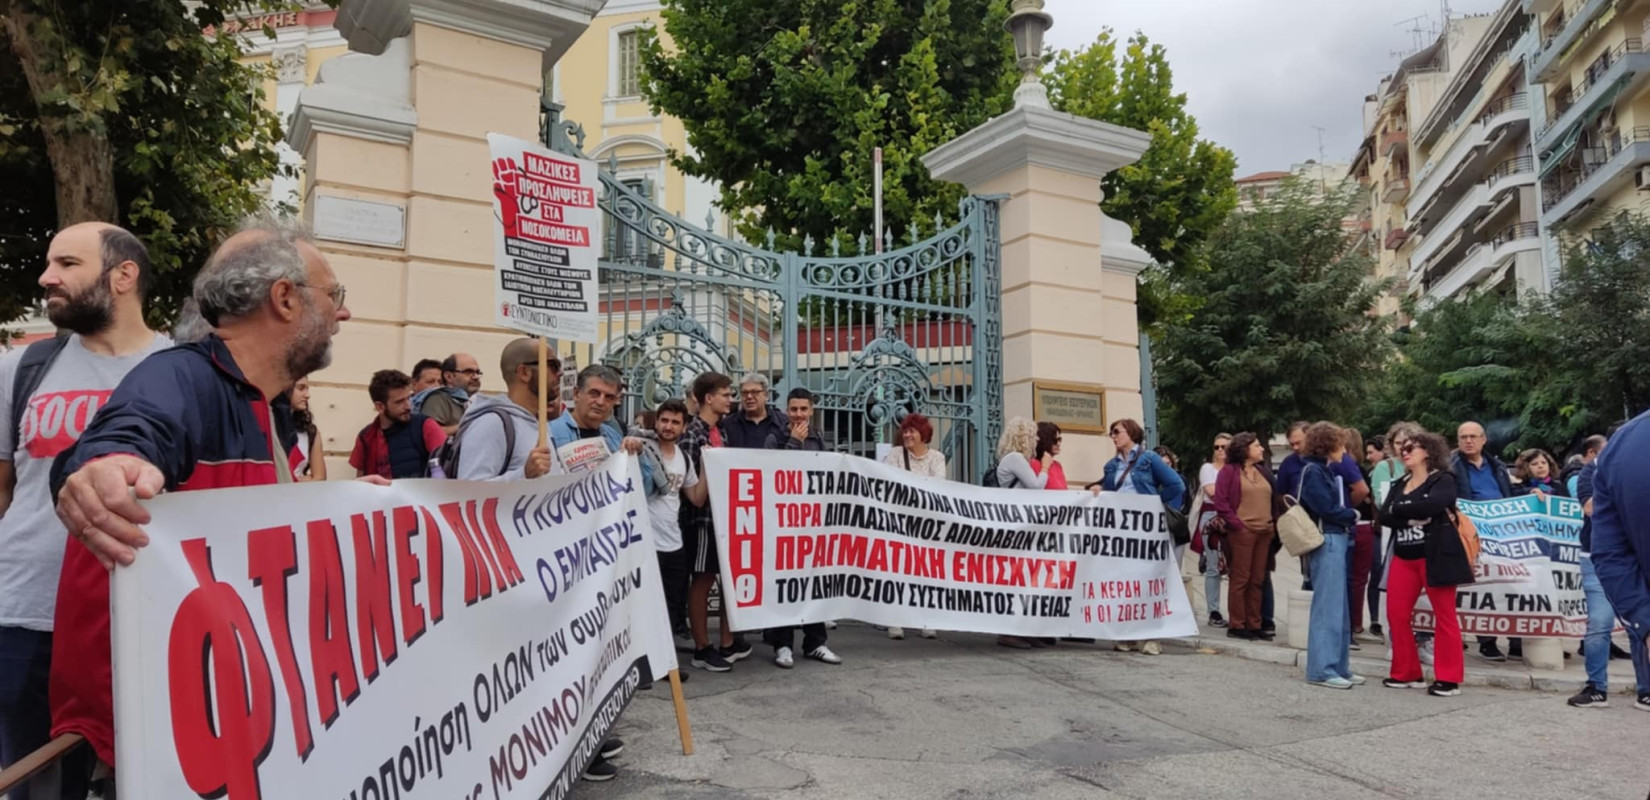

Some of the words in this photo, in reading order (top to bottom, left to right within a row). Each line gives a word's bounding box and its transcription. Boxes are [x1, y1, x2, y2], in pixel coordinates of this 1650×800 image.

[518, 177, 591, 206] ΠΡΟΣΛΗΨΕΙΣ
[527, 156, 577, 182] ΜΑΖΙΚΕΣ
[521, 219, 586, 244] ΝΟΣΟΚΟΜΕΙΑ
[543, 204, 561, 220] ΣΤΑ
[512, 493, 537, 538] Η
[774, 469, 803, 495] ΟΧΙ
[806, 470, 834, 495] ΣΤΑ
[835, 471, 955, 515] ΑΠΟΓΕΥΜΑΤΙΝΑ
[952, 497, 1024, 523] ΙΔΙΩΤΙΚΑ
[1023, 504, 1116, 529] ΧΕΙΡΟΥΡΓΕΙΑ
[1119, 509, 1154, 533] ΣΤΟ
[775, 503, 821, 528] ΤΩΡΑ
[824, 502, 946, 542] ΔΙΠΛΑΣΙΑΣΜΟΣ
[944, 522, 1036, 551] ΑΠΟΛΑΒΩΝ
[1036, 531, 1064, 553] ΚΑΙ
[775, 523, 946, 580] ΠΡΑΓΜΑΤΙΚΗ
[952, 551, 1077, 590] ΕΝΙΣΧΥΣΗ
[536, 557, 558, 603] Ο
[776, 577, 809, 604] ΤΟΥ
[811, 573, 905, 605] ΔΗΜΟΣΙΟΥ
[908, 583, 1015, 616] ΣΥΣΤΗΜΑΤΟΣ
[1019, 594, 1072, 618] ΥΓΕΙΑΣ
[1082, 581, 1095, 600] ΤΑ
[1101, 580, 1141, 599] ΚΕΡΔΗ
[1457, 591, 1496, 612] ΓΙΑ
[1504, 593, 1552, 612] ΤΗΝ
[1097, 604, 1112, 624] ΟΙ
[1117, 603, 1147, 622] ΖΩΕΣ
[167, 504, 444, 800] ΦΤΑΝΕΙ
[437, 496, 526, 607] ΠΙΑ
[473, 639, 535, 723] ΟΛΩΝ
[536, 627, 569, 673] των
[488, 674, 586, 800] ΜΟΝΙΜΟΥ
